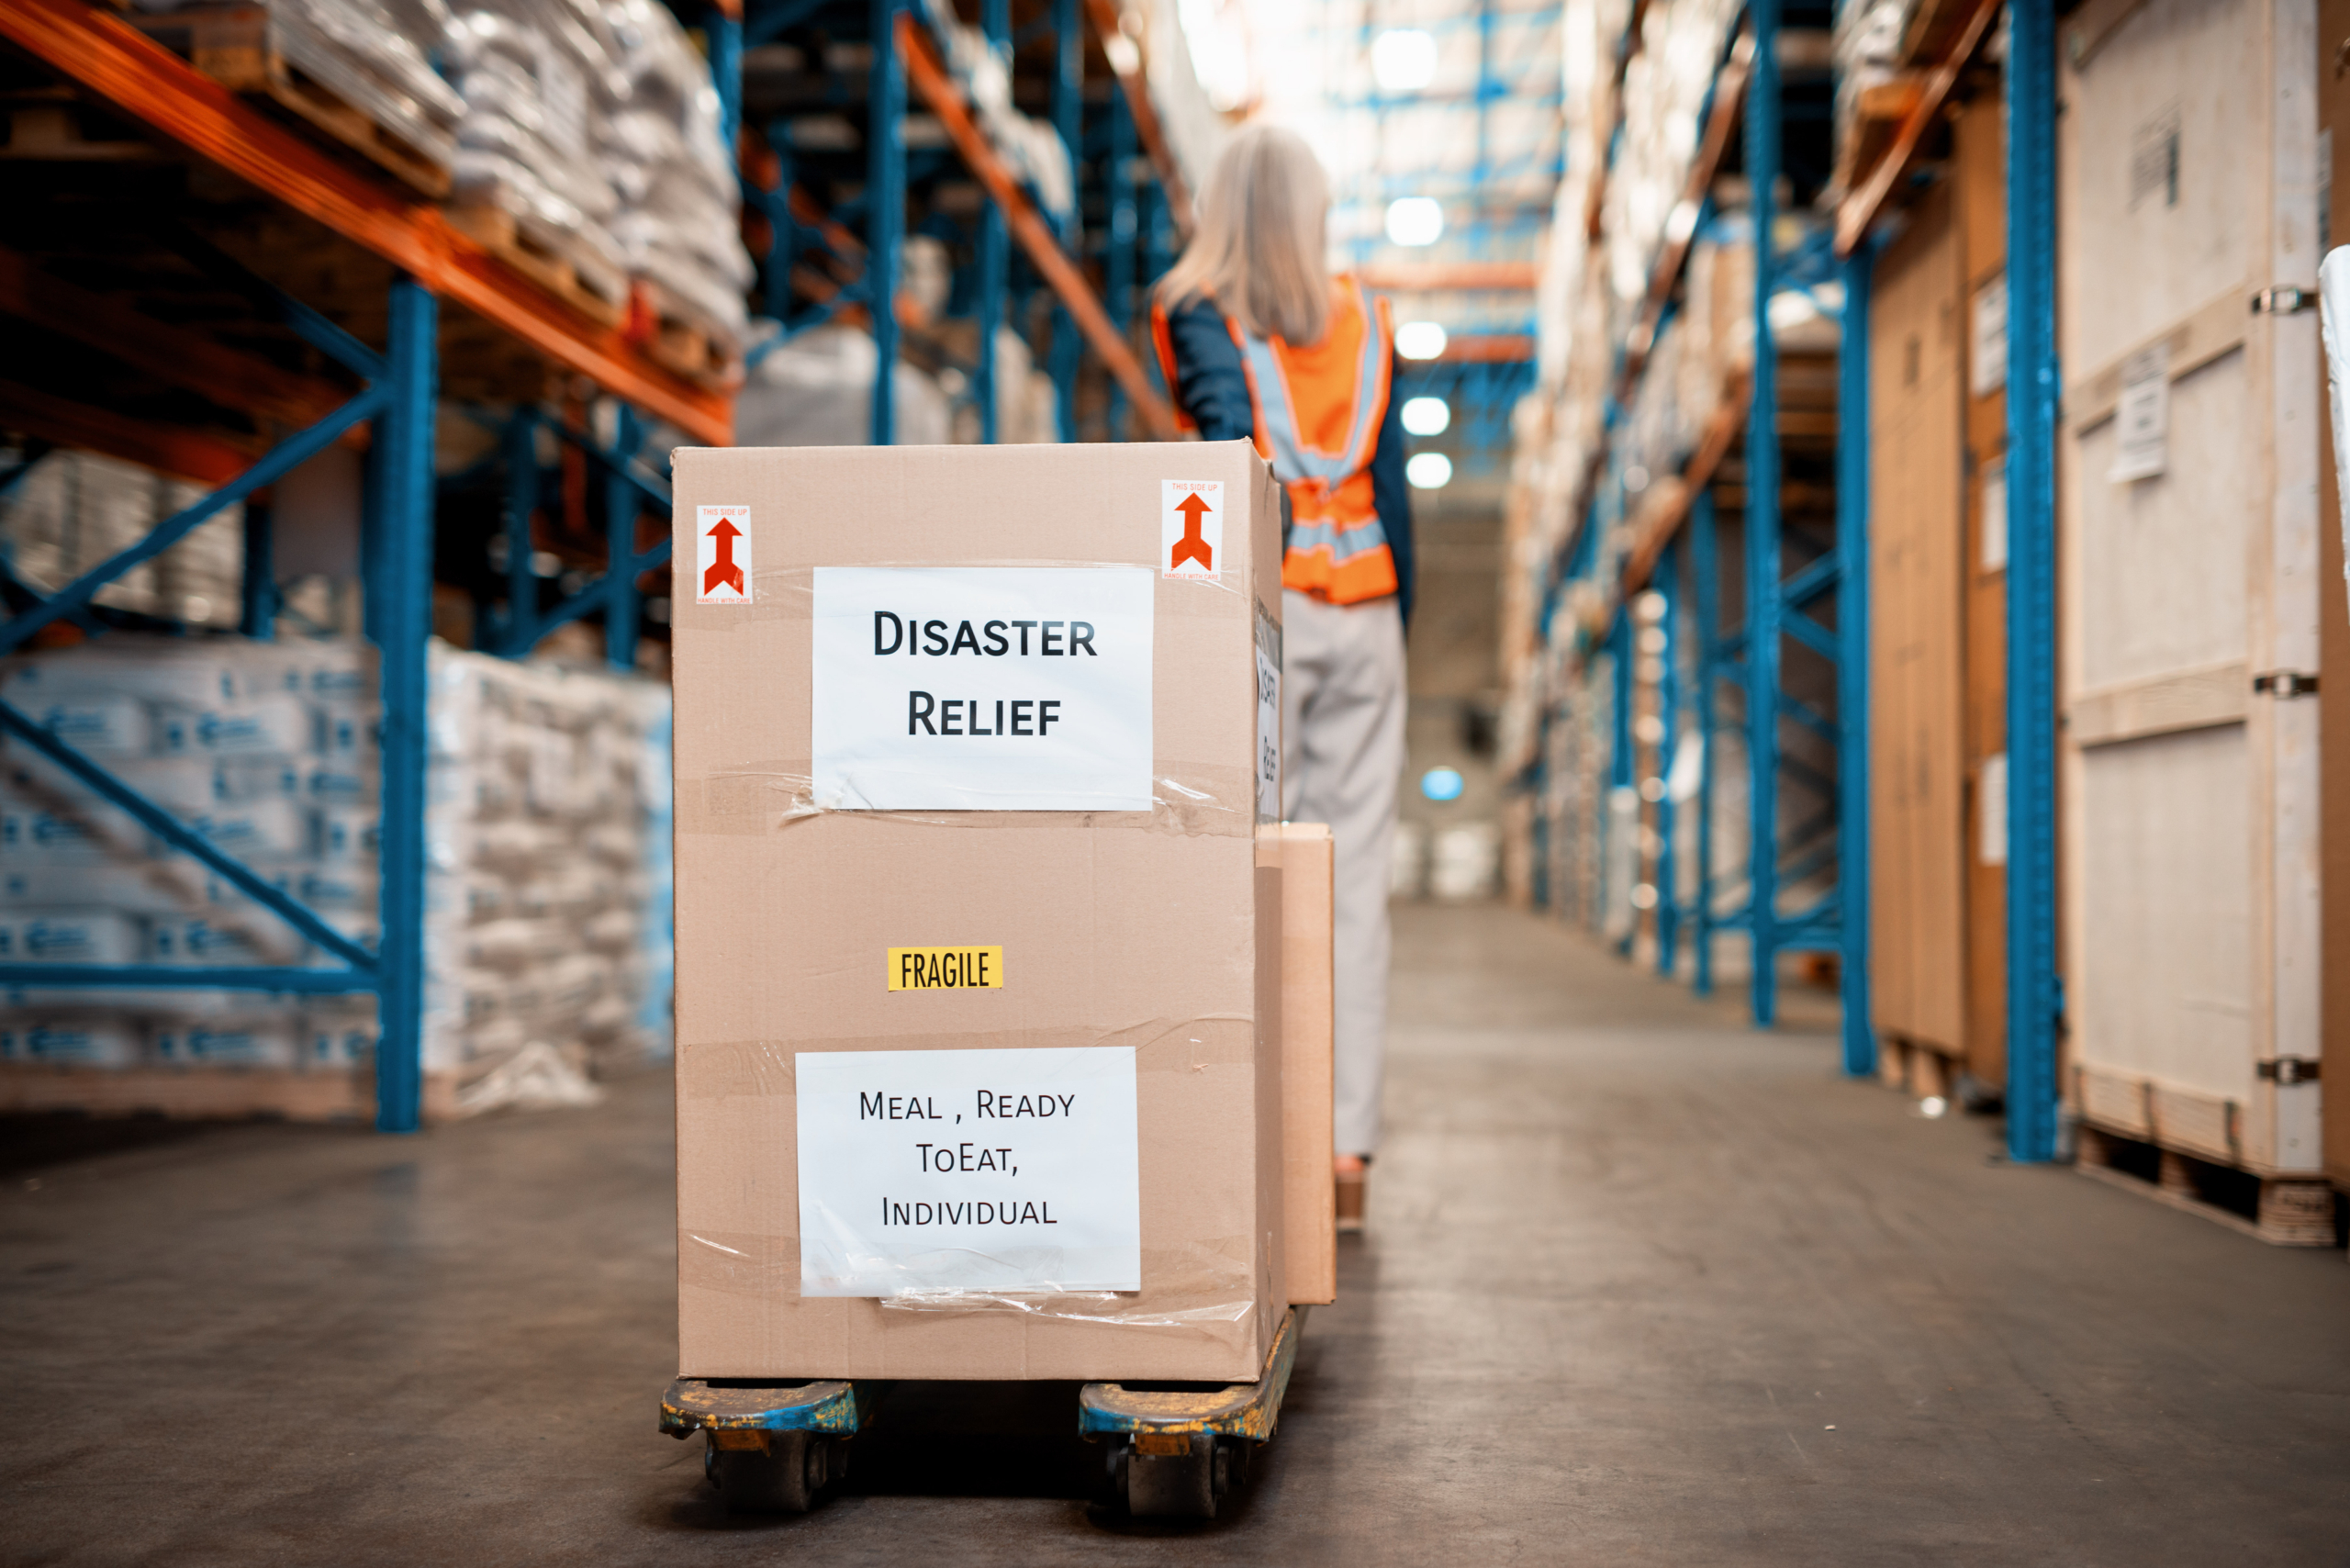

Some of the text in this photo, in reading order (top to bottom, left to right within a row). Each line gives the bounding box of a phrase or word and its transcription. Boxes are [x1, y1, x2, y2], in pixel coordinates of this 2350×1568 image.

[1171, 482, 1189, 491] THIS
[1190, 483, 1206, 491] SIDE
[702, 508, 748, 516] THIS SIDE UP
[874, 610, 1099, 657] DISASTER
[908, 690, 1061, 736] RELIEF
[901, 952, 990, 989] FRAGILE
[859, 1091, 943, 1121] MEAL
[977, 1089, 1076, 1119] READY
[915, 1142, 1019, 1177] TOEAT,
[882, 1196, 1058, 1226] INDIVIDUAL
